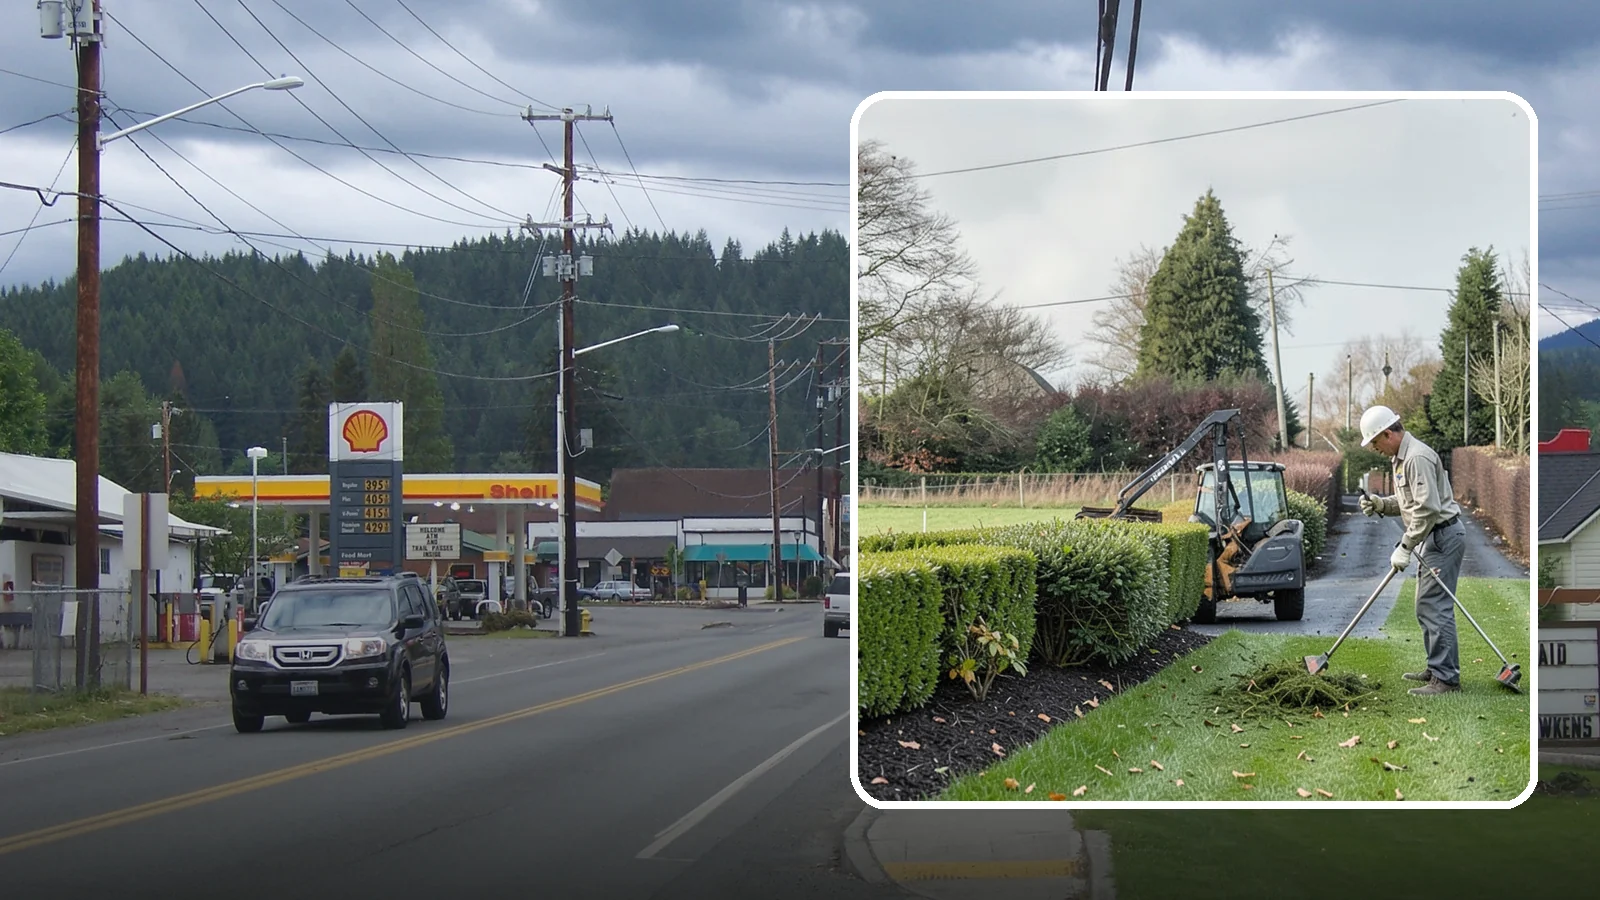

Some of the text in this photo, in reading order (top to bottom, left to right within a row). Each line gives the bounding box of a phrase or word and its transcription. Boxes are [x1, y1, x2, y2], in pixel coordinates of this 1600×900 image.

[365, 480, 383, 490] 395
[490, 484, 547, 499] Shell
[365, 494, 383, 504] 405
[365, 508, 383, 518] 415
[365, 522, 383, 532] 429
